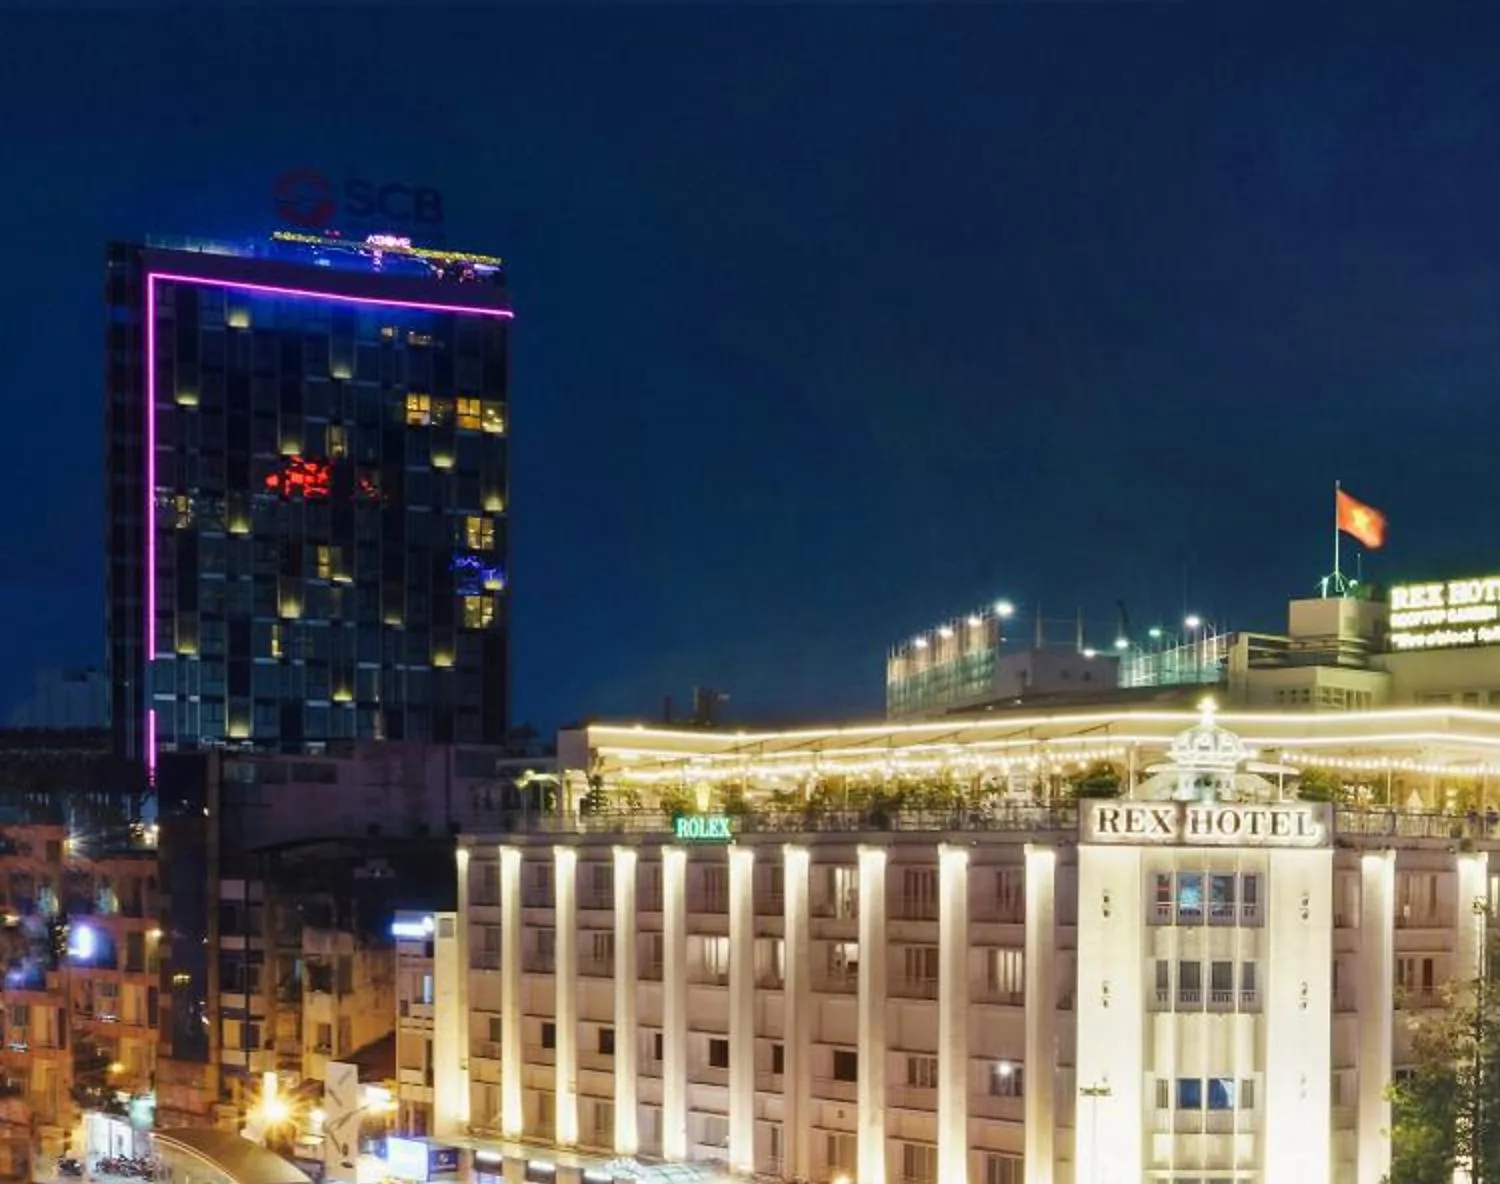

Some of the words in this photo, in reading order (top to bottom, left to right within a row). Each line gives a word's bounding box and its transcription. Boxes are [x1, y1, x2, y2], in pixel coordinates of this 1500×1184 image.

[344, 178, 444, 222] SCB
[1391, 583, 1444, 610] REX
[676, 816, 732, 838] ROLEX
[1098, 807, 1172, 834] REX
[1189, 809, 1318, 837] HOTEL
